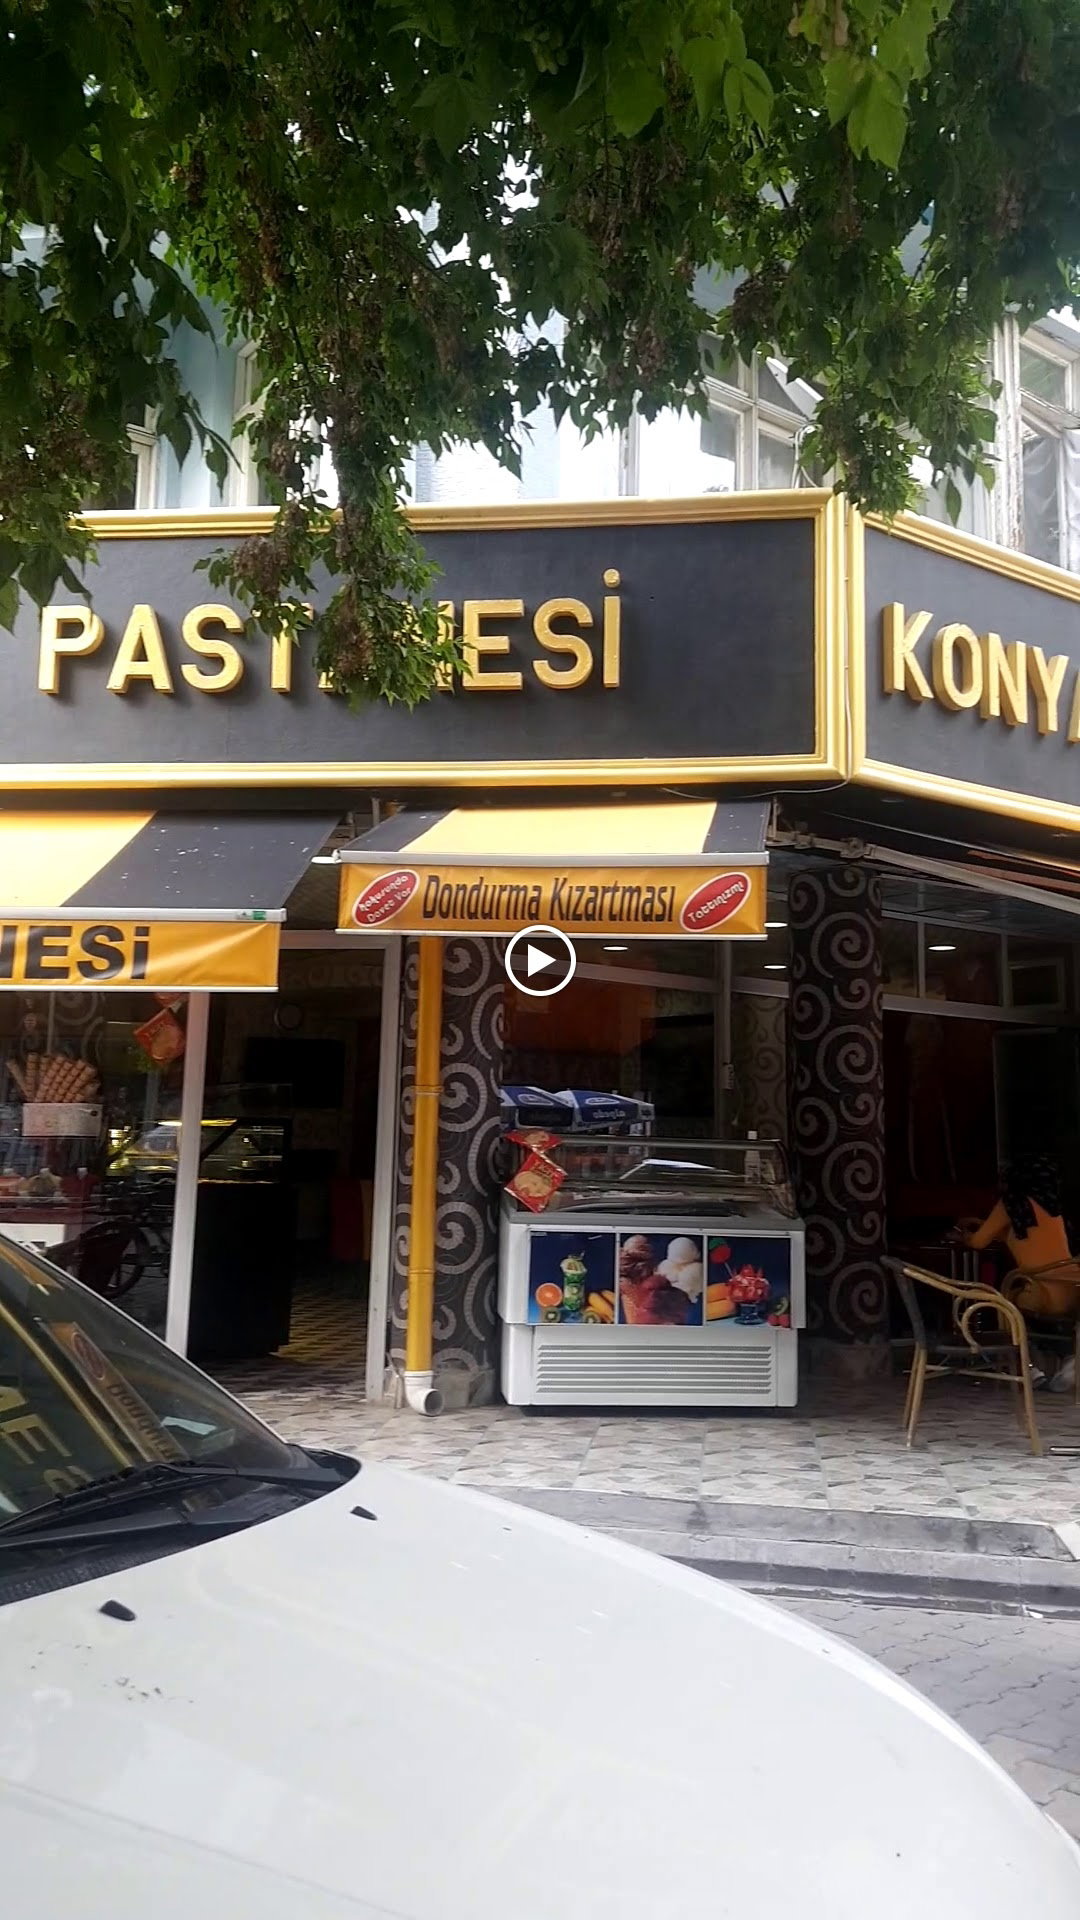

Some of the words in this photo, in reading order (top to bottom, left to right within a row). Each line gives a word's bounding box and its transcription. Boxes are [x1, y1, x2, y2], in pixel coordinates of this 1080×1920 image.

[37, 568, 622, 694] PASTESİ
[423, 875, 543, 921] Dondurma
[549, 877, 676, 923] Kızartması
